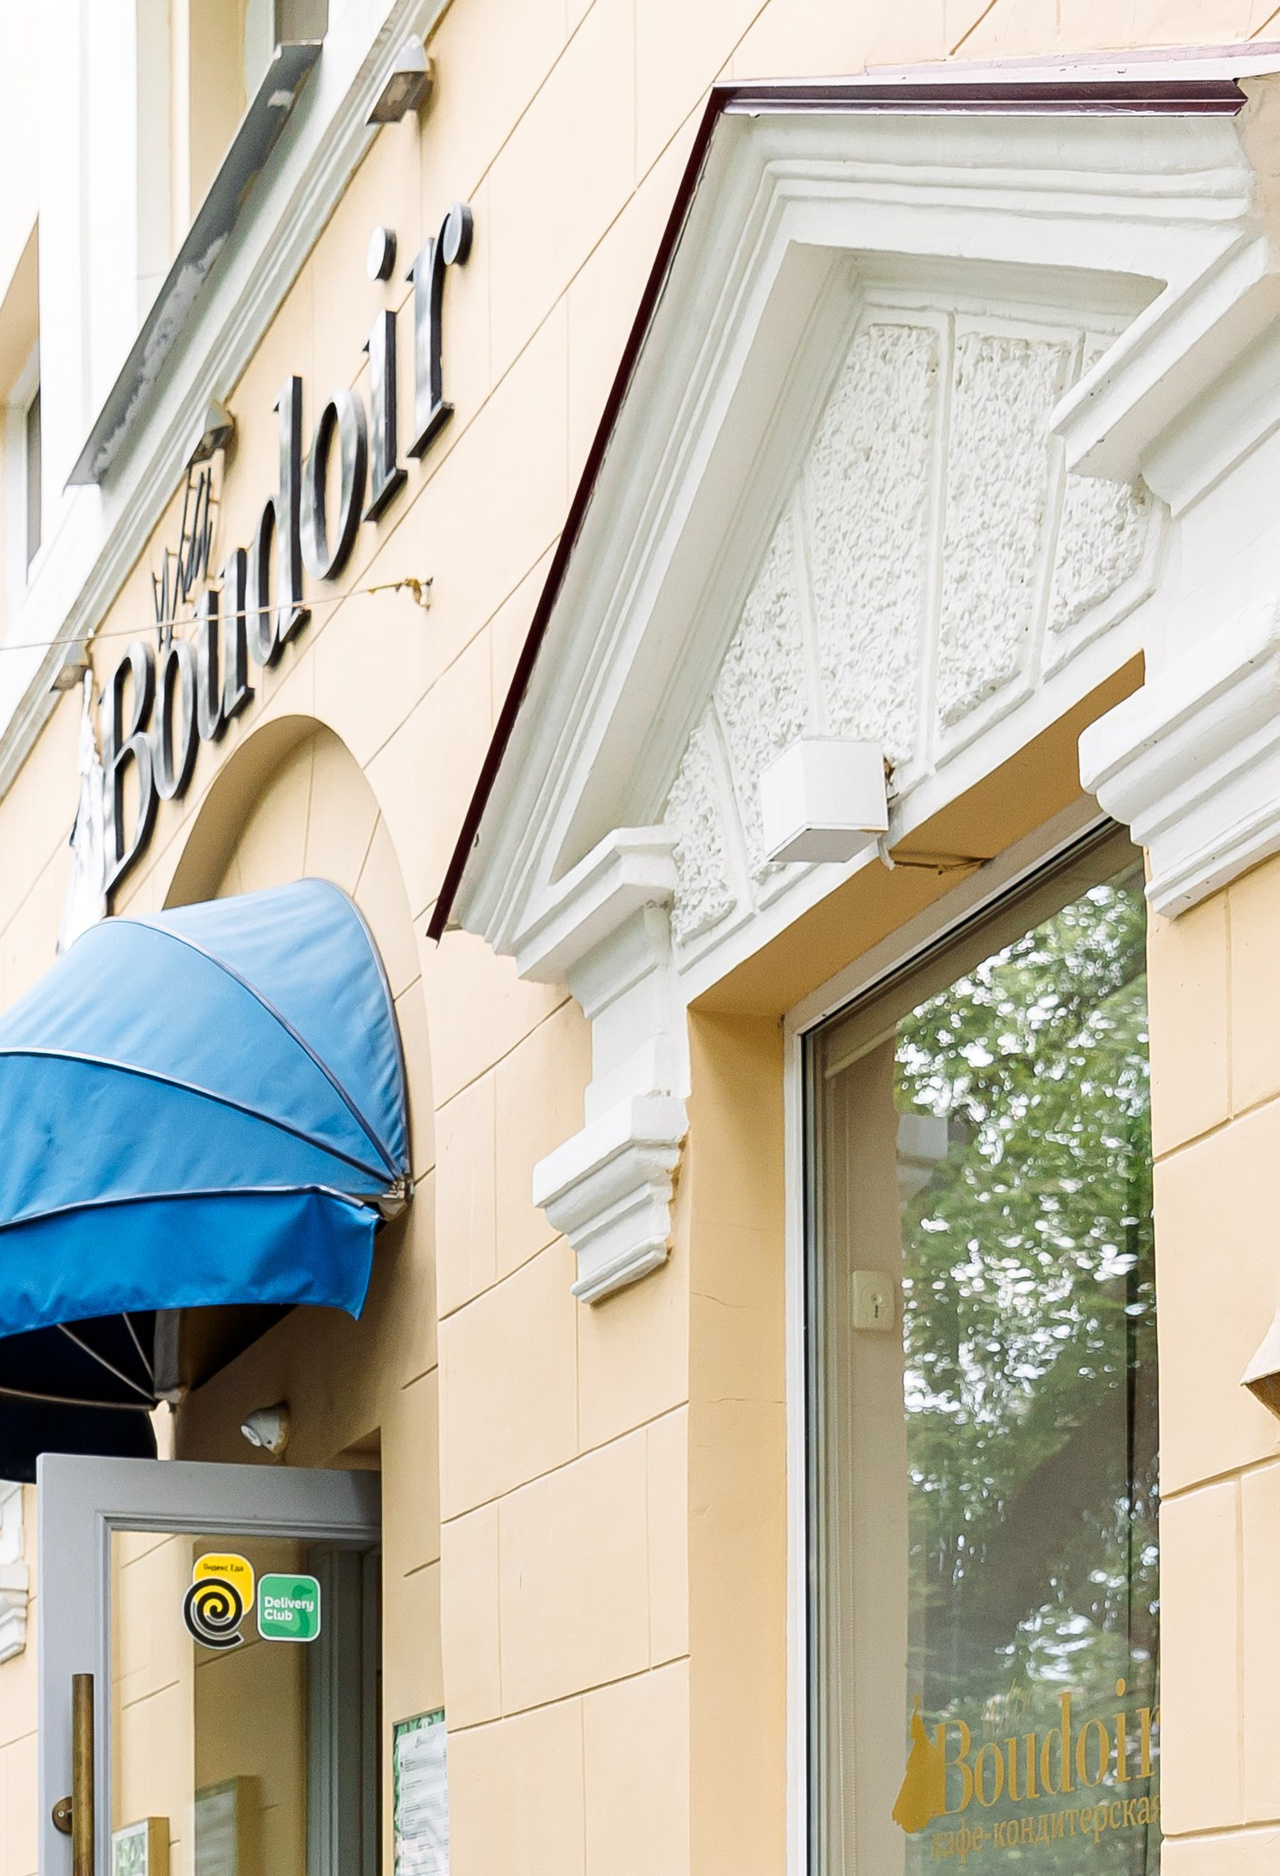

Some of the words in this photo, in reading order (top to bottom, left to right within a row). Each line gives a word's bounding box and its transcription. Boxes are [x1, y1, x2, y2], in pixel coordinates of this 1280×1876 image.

[100, 202, 473, 897] Boudoir
[264, 1596, 314, 1612] Delivery
[264, 1609, 293, 1621] Club
